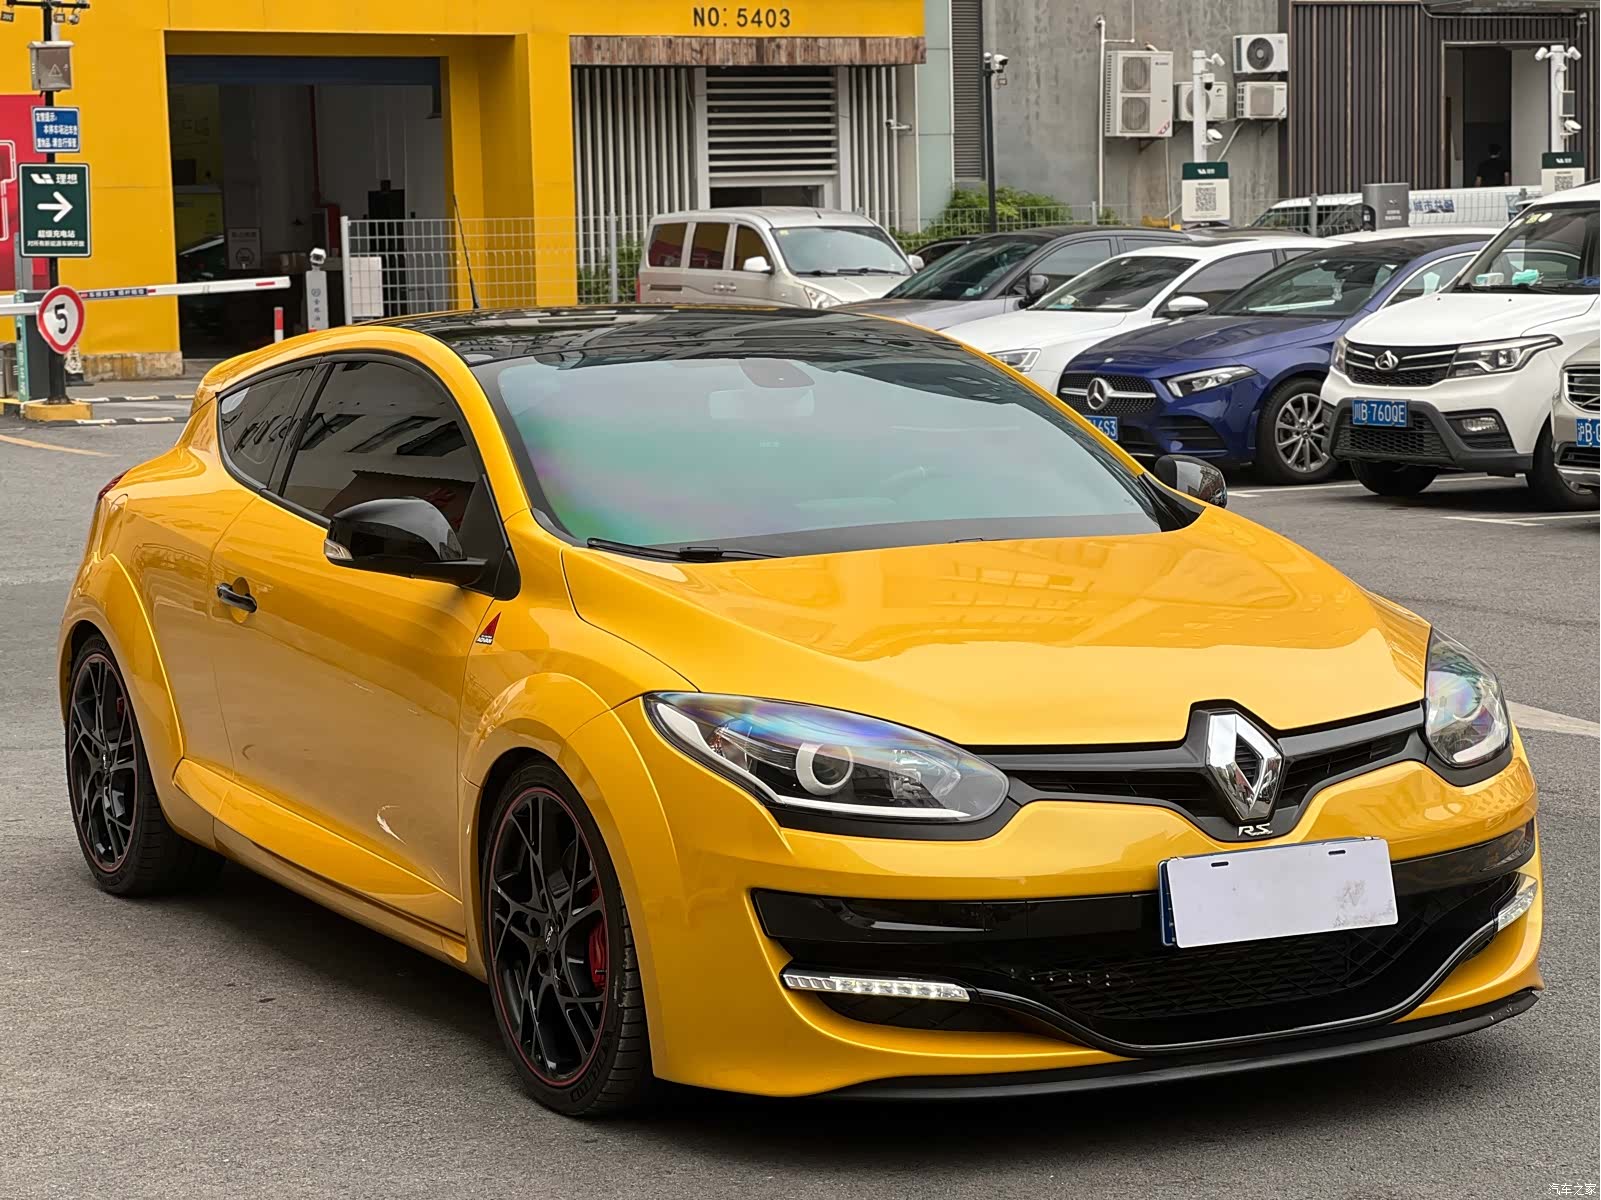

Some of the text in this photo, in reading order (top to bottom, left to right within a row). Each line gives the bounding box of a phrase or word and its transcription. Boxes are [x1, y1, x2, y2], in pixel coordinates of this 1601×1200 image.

[737, 8, 791, 28] 5403
[55, 173, 78, 184] 理想
[54, 303, 68, 334] 5
